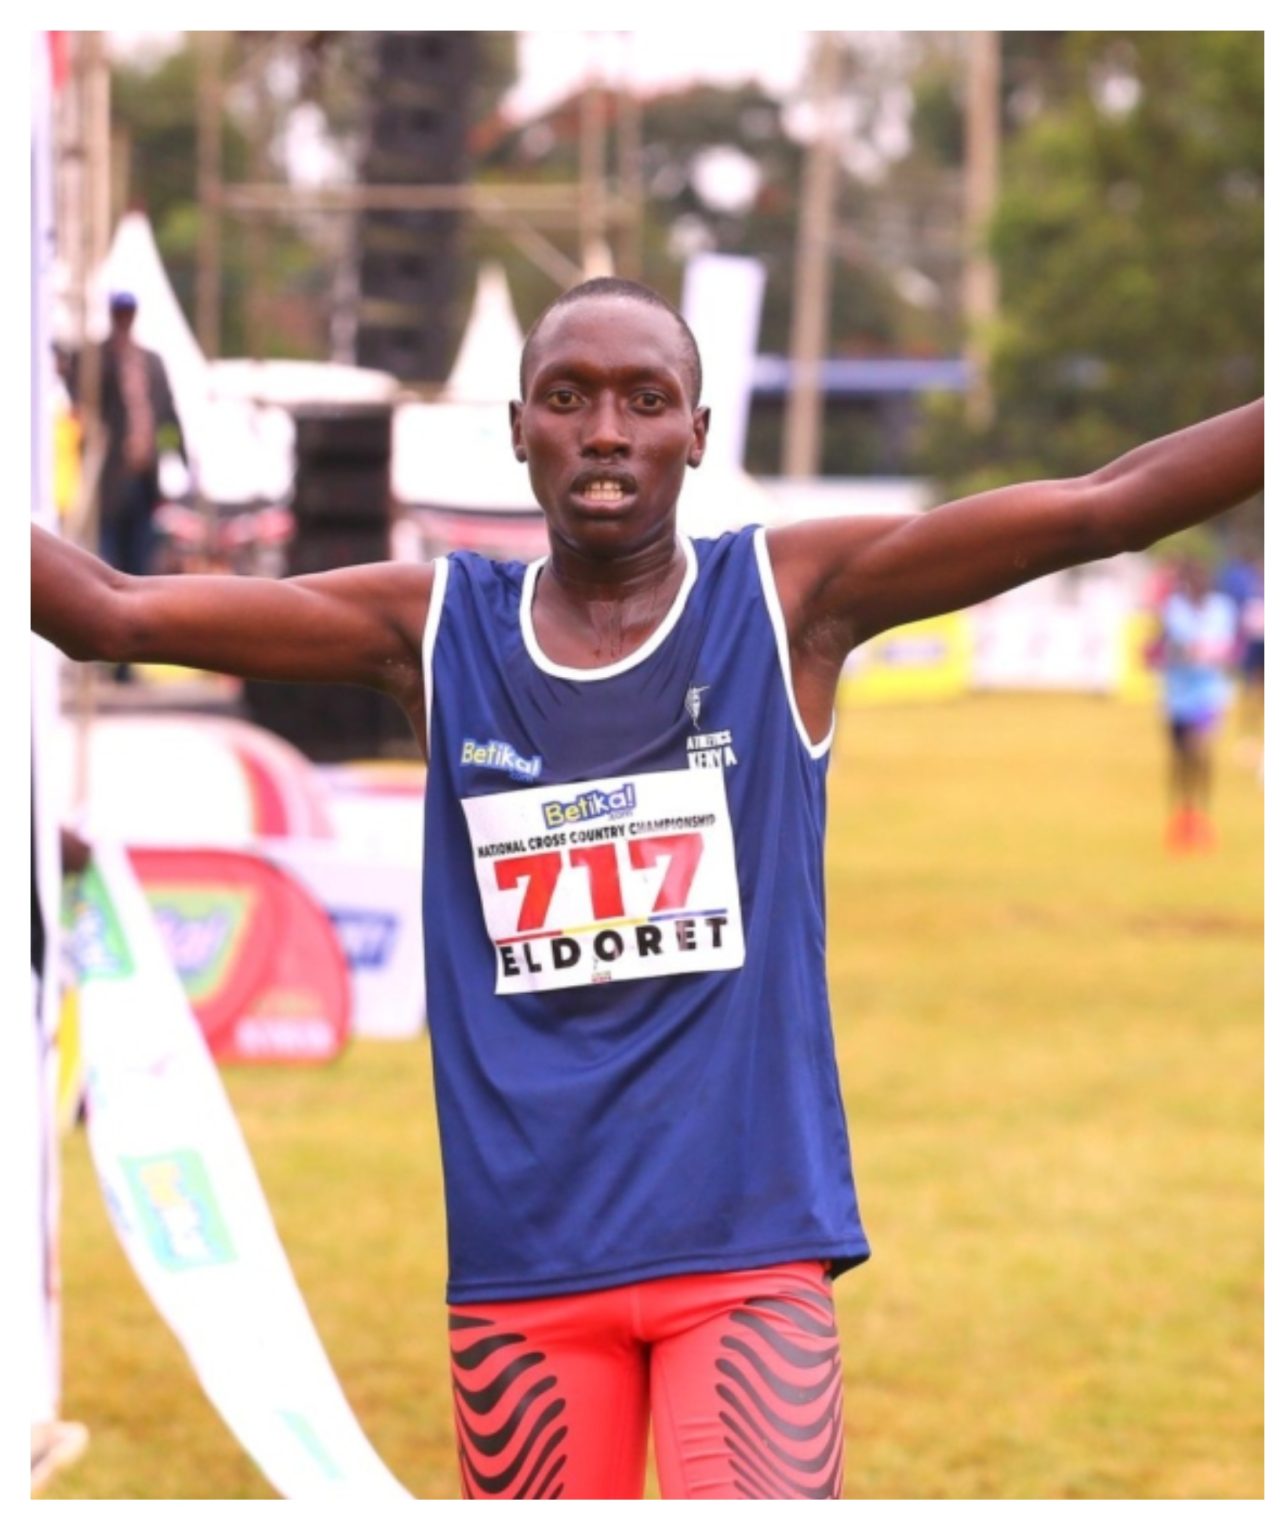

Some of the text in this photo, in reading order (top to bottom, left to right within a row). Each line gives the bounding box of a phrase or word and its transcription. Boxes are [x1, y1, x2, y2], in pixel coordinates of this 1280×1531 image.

[461, 738, 541, 777] Betika!
[541, 783, 637, 830] Betika!
[477, 812, 717, 858] NATIONAL CROSS COUNTRY CHAMPIONSHIP
[493, 831, 705, 933] 717
[501, 916, 728, 977] ELDORET
